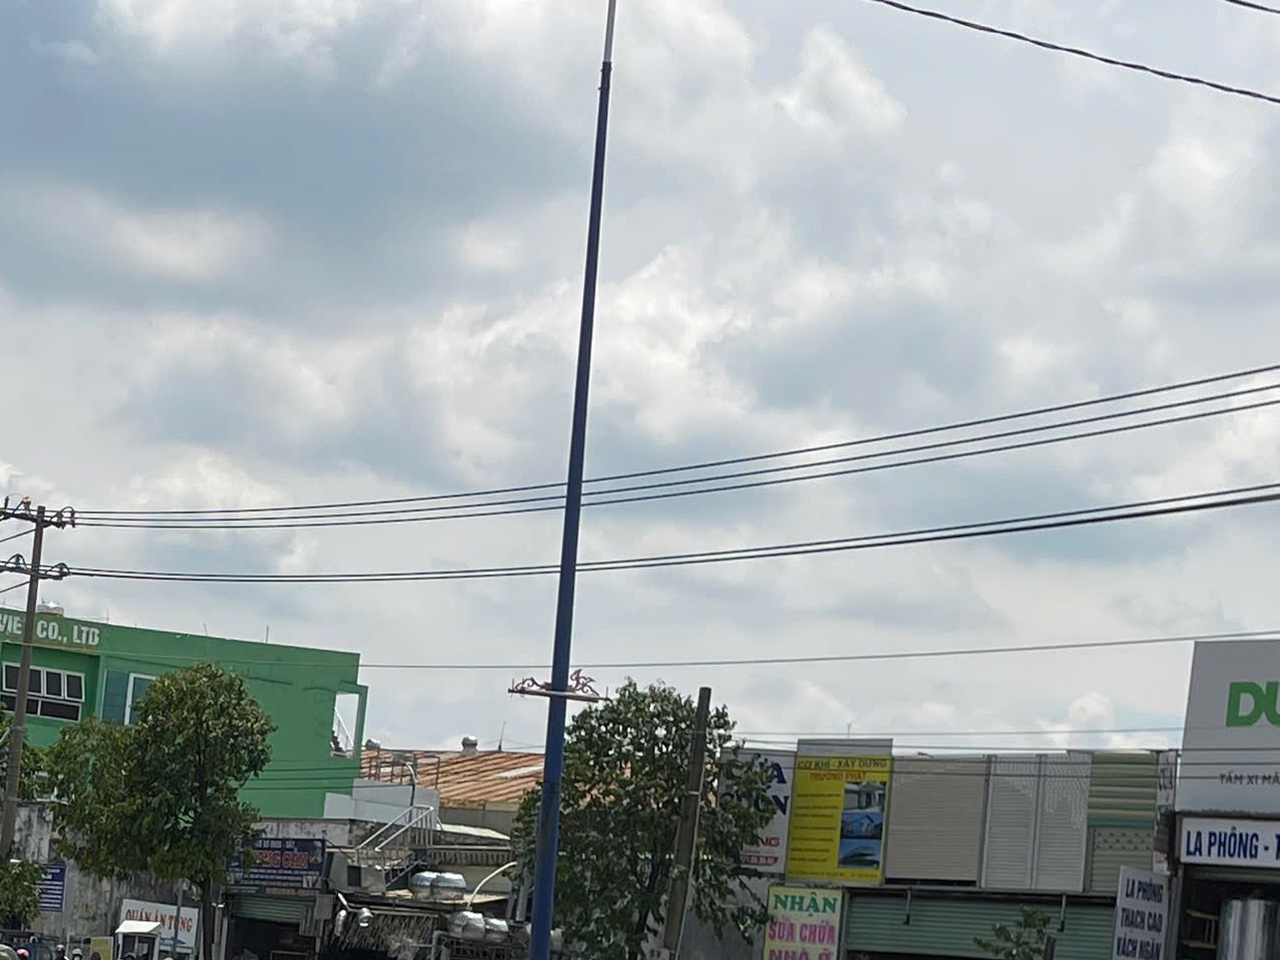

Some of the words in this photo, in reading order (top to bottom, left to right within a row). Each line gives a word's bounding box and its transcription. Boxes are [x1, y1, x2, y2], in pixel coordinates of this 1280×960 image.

[36, 620, 67, 643] CO.,
[73, 625, 100, 646] LTD
[1247, 774, 1259, 786] XI
[1185, 830, 1203, 857] LA
[1207, 826, 1260, 860] PHÔNG
[1125, 878, 1135, 899] LA
[773, 892, 838, 917] NHẬN
[168, 914, 194, 934] TNG
[769, 917, 795, 941] SỬA
[800, 920, 835, 945] CHỮA
[1147, 911, 1163, 933] CAO
